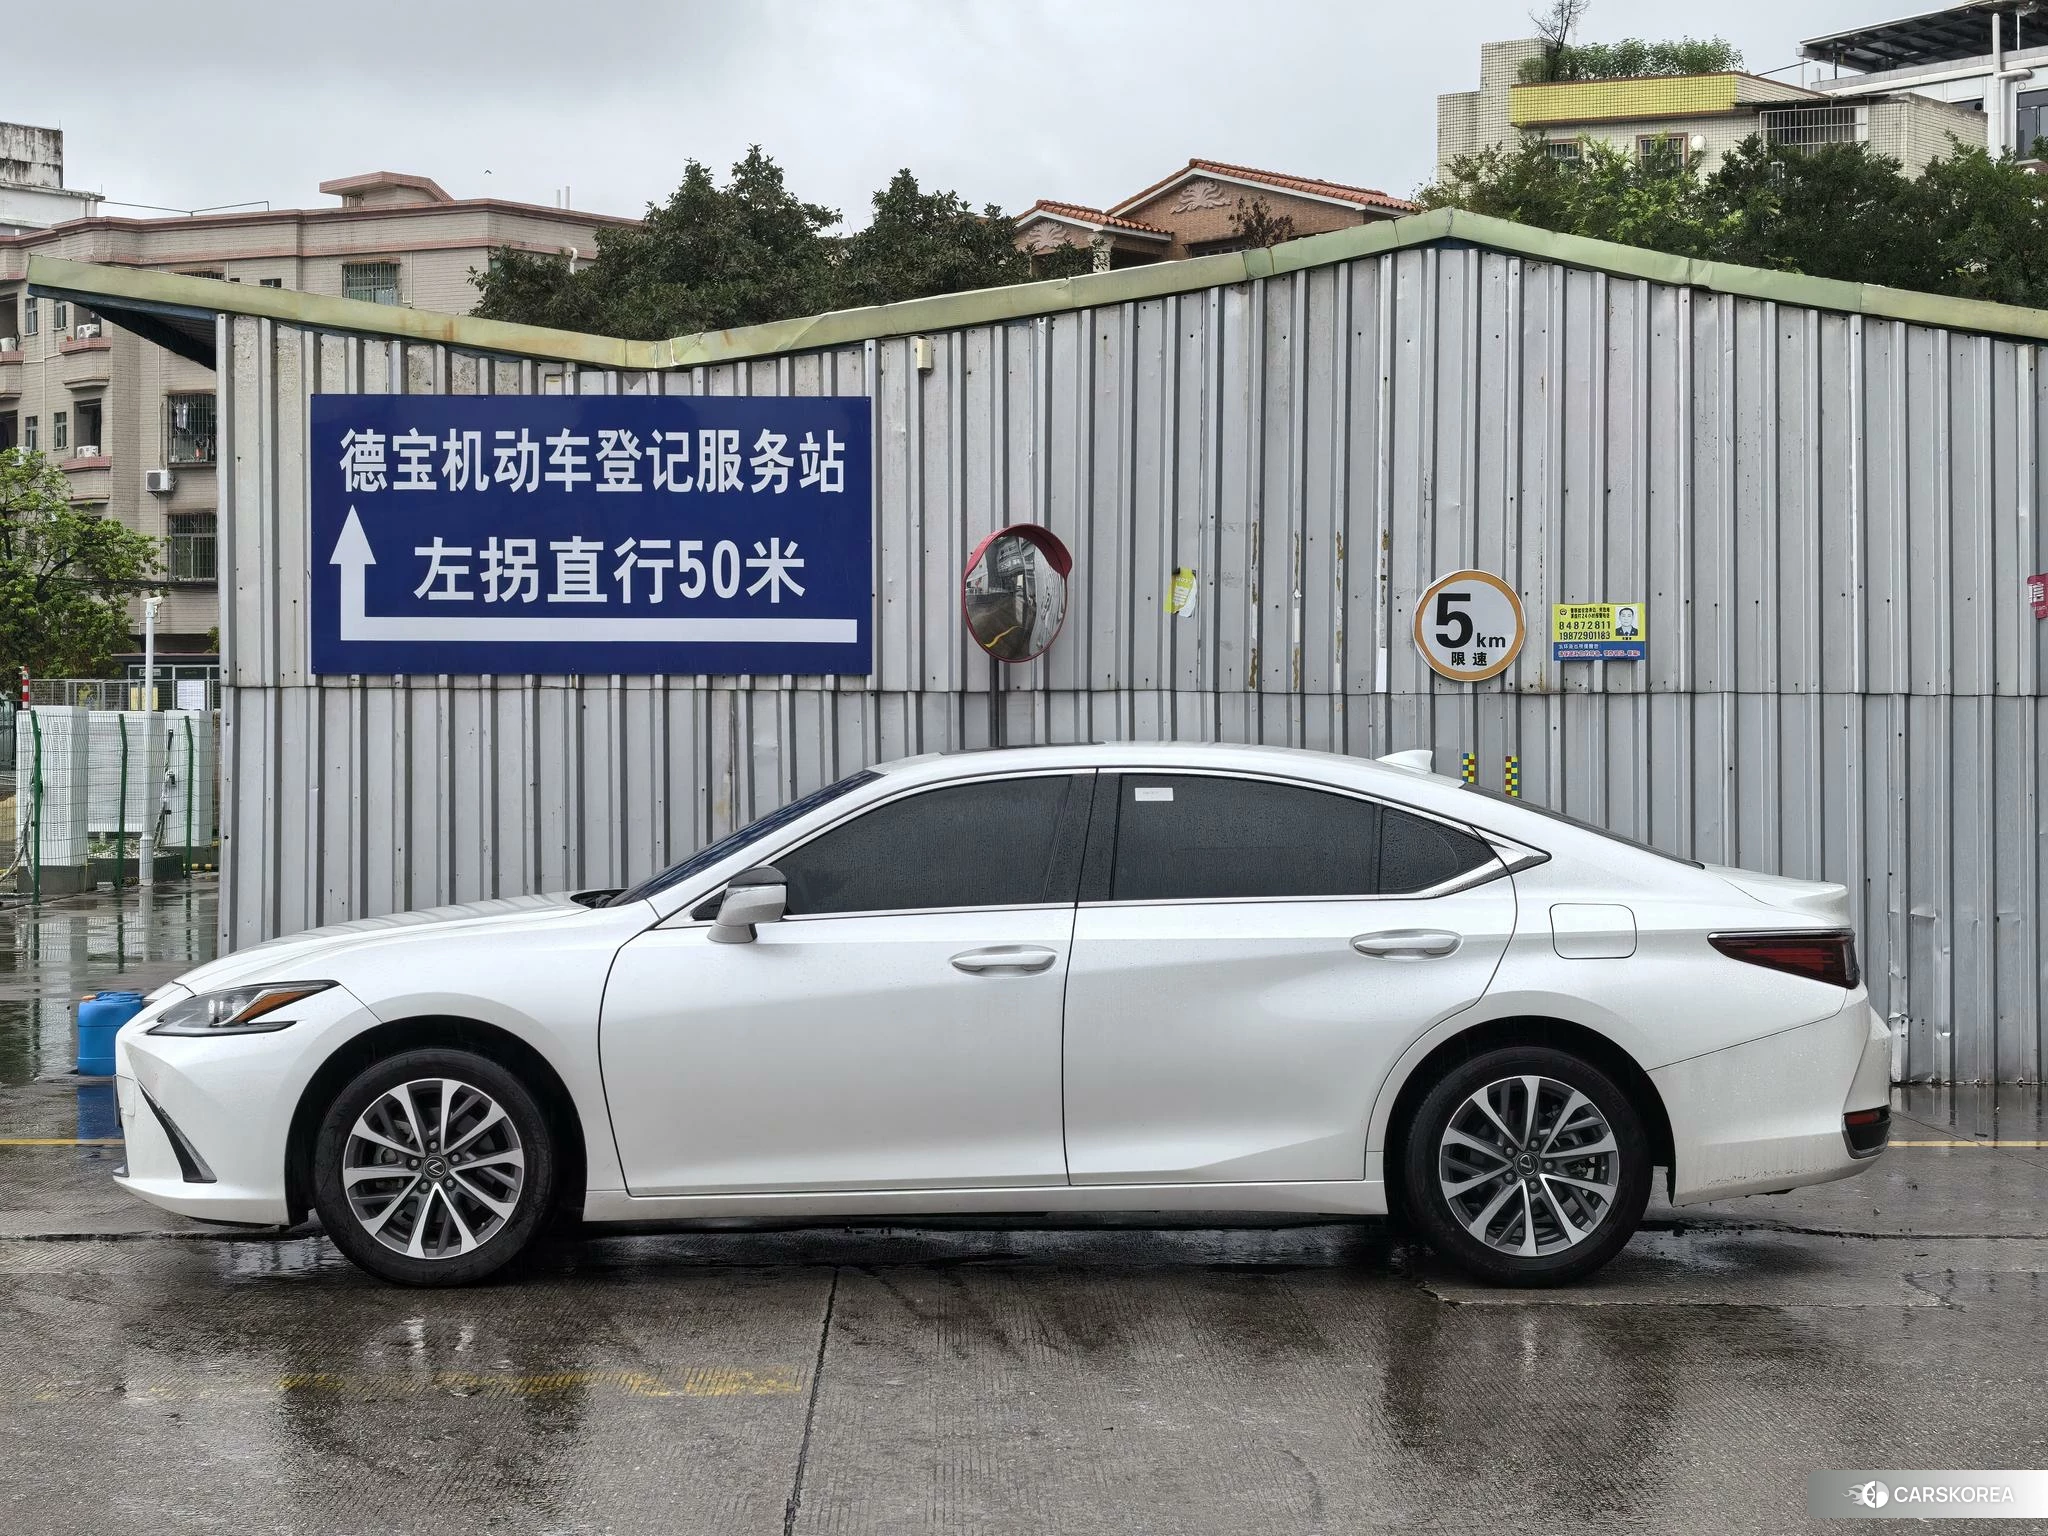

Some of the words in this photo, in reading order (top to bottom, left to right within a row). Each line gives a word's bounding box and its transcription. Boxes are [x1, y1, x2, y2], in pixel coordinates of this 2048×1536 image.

[339, 427, 846, 493] 德宝机动车登记服务站
[412, 535, 806, 604] 左拐直行50米
[1559, 620, 1611, 630] 84872811
[1559, 631, 1611, 641] 19872901183
[1451, 651, 1488, 666] 限速
